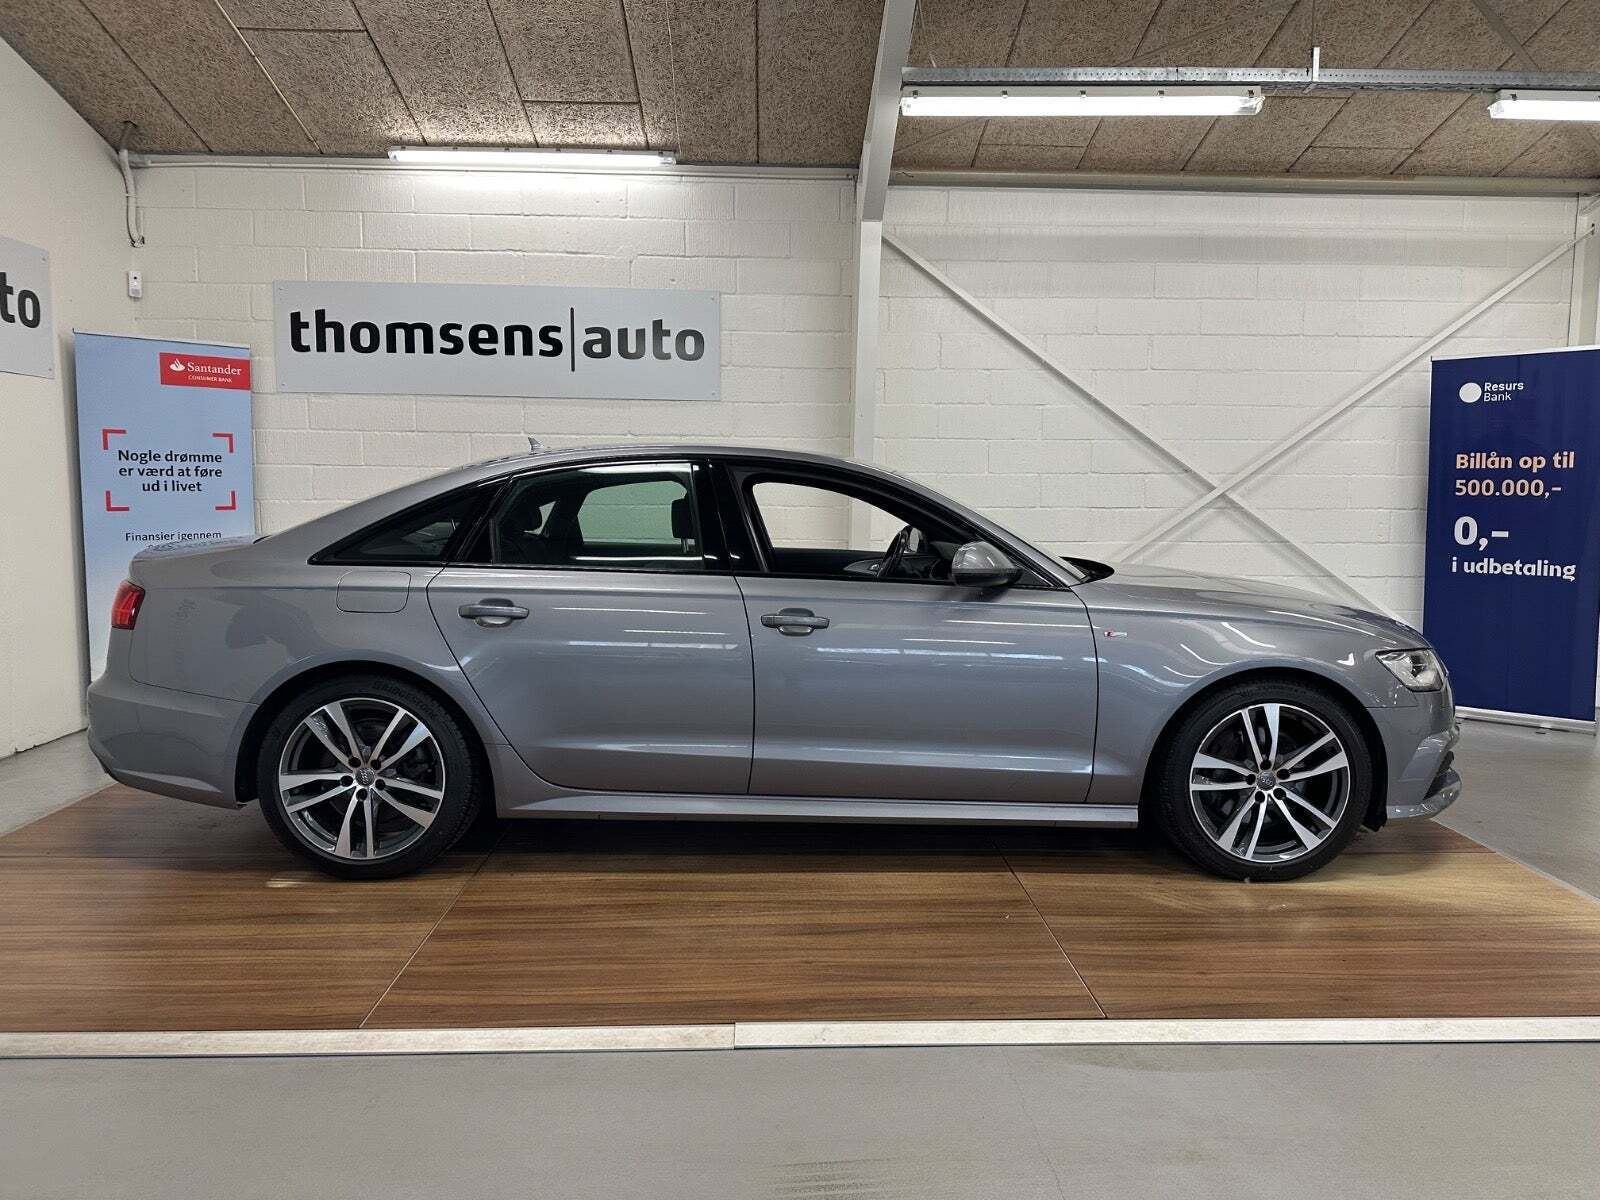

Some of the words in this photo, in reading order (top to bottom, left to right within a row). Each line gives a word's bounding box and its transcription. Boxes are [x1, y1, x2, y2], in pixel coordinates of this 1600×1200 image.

[0, 273, 41, 329] to
[187, 362, 242, 375] Santander
[1484, 382, 1524, 391] Resurs
[1484, 392, 1512, 402] Bank
[118, 449, 161, 464] Nogle
[164, 450, 222, 463] drømme
[1456, 452, 1513, 469] Billån
[1519, 456, 1546, 473] op
[1552, 451, 1575, 469] til
[118, 467, 134, 476] er
[137, 465, 174, 477] værd
[177, 467, 191, 477] at
[194, 466, 223, 477] føre
[142, 480, 160, 492] ud
[164, 480, 168, 492] i
[171, 480, 202, 492] livet
[125, 532, 175, 542] Finansier
[177, 532, 222, 541] igennem
[1451, 556, 1457, 573] i
[1463, 557, 1577, 582] udbetaling
